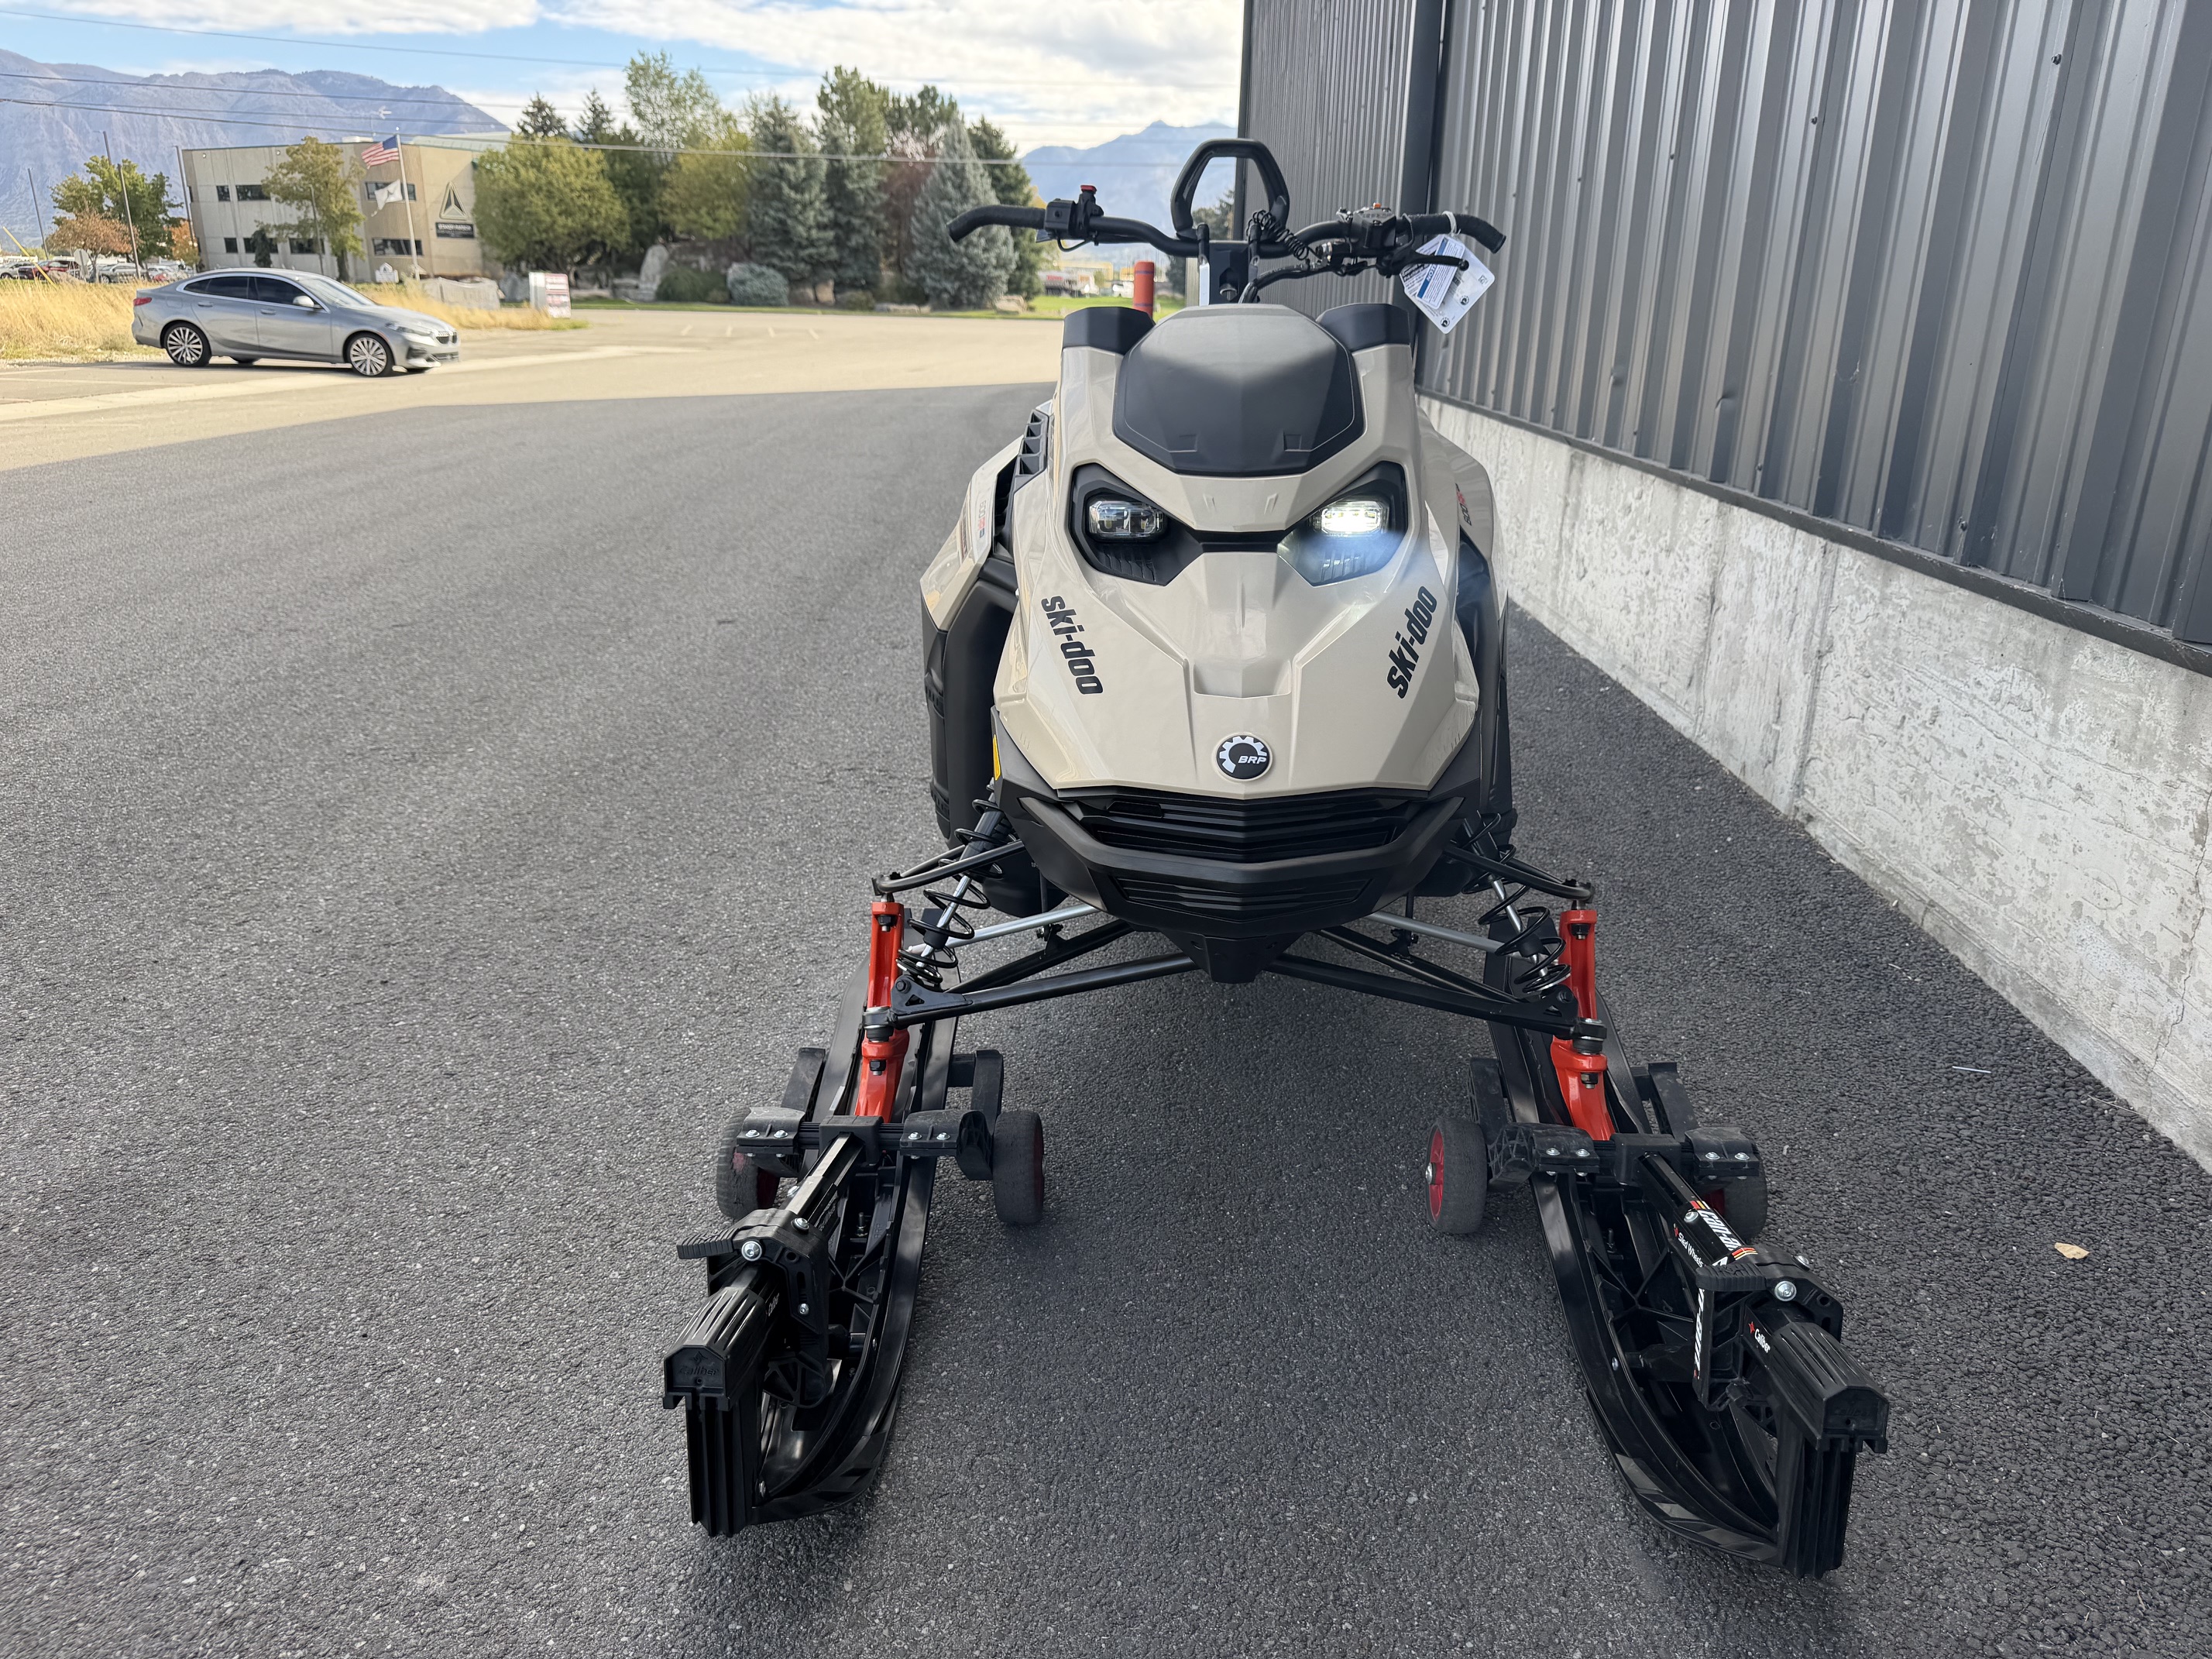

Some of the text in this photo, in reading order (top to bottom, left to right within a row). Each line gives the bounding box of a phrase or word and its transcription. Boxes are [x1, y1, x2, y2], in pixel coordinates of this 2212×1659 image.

[1041, 596, 1104, 695] ski-doo
[1386, 586, 1437, 699] ski-doo
[1238, 755, 1267, 764] BRP
[1678, 1232, 1704, 1268] Sled Wheels
[1754, 1328, 1771, 1354] Caliber
